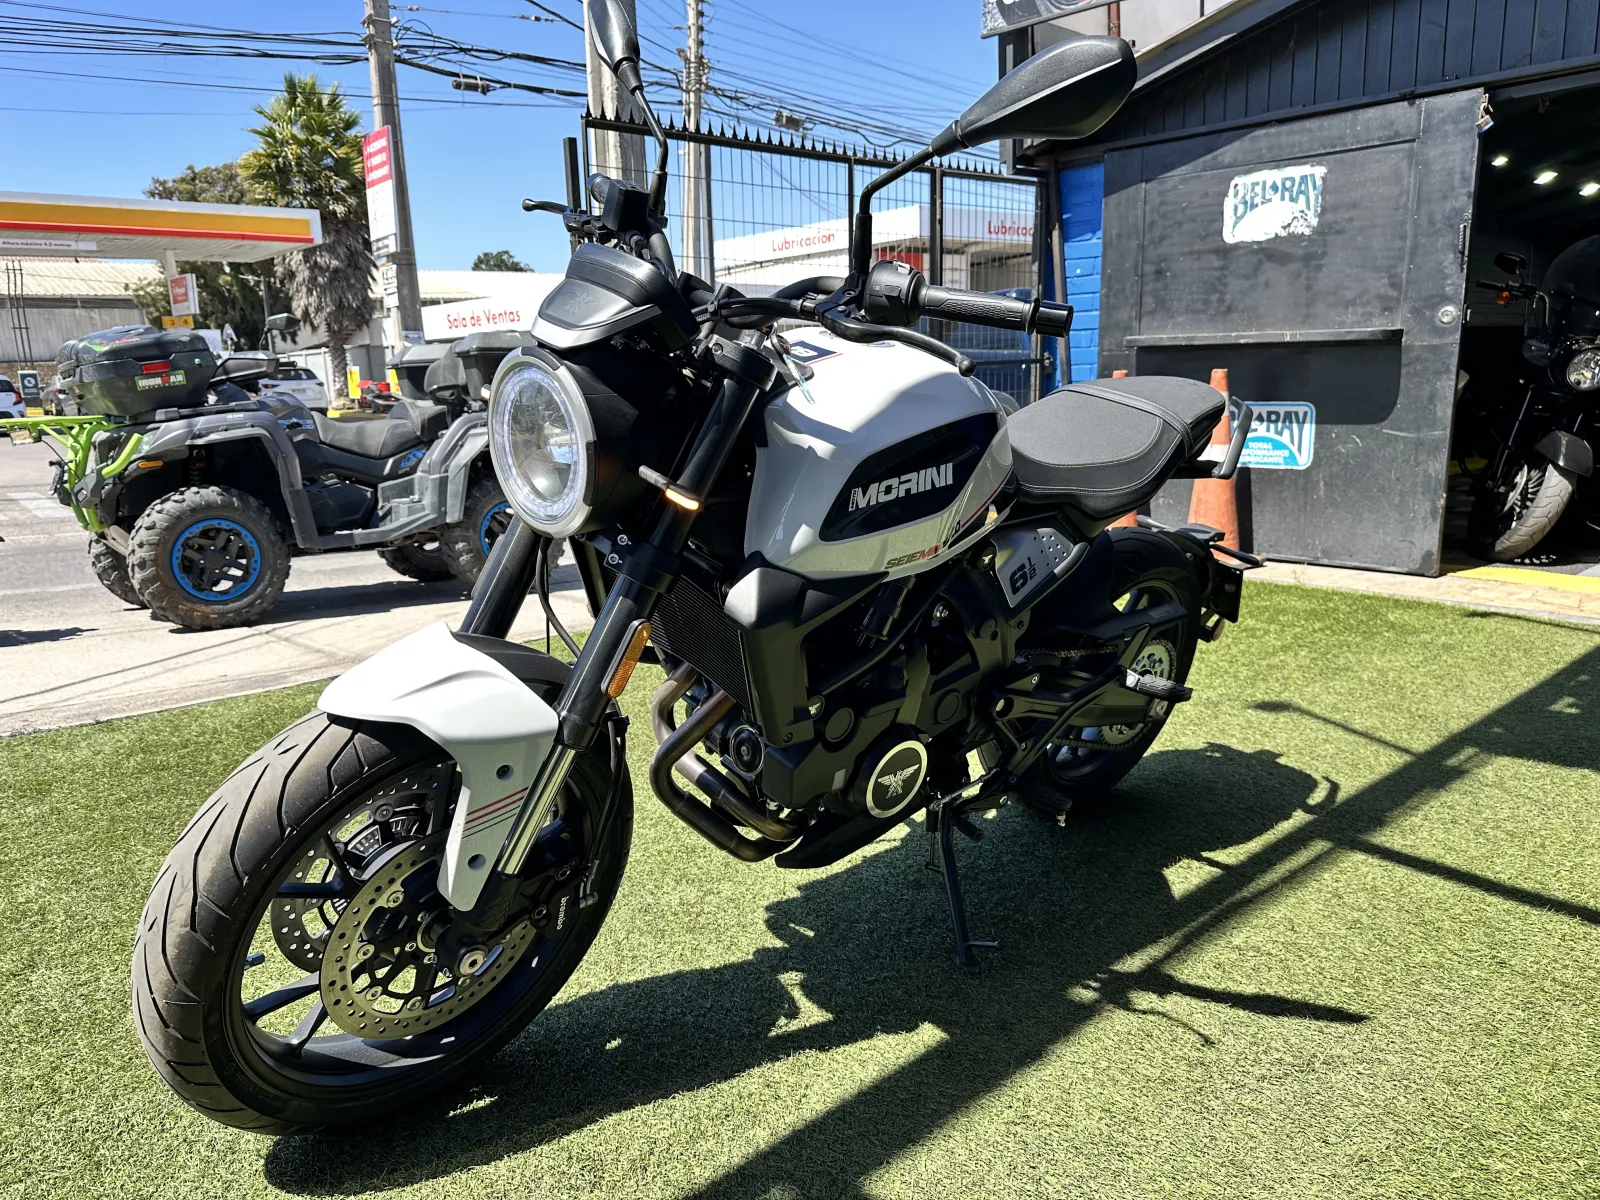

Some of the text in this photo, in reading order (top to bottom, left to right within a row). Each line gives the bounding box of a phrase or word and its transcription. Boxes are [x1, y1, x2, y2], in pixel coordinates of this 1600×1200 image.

[447, 309, 521, 329] Sala de Ventas
[1248, 441, 1273, 450] TOTAL
[858, 462, 954, 509] MORINI
[556, 895, 570, 931] brembo
